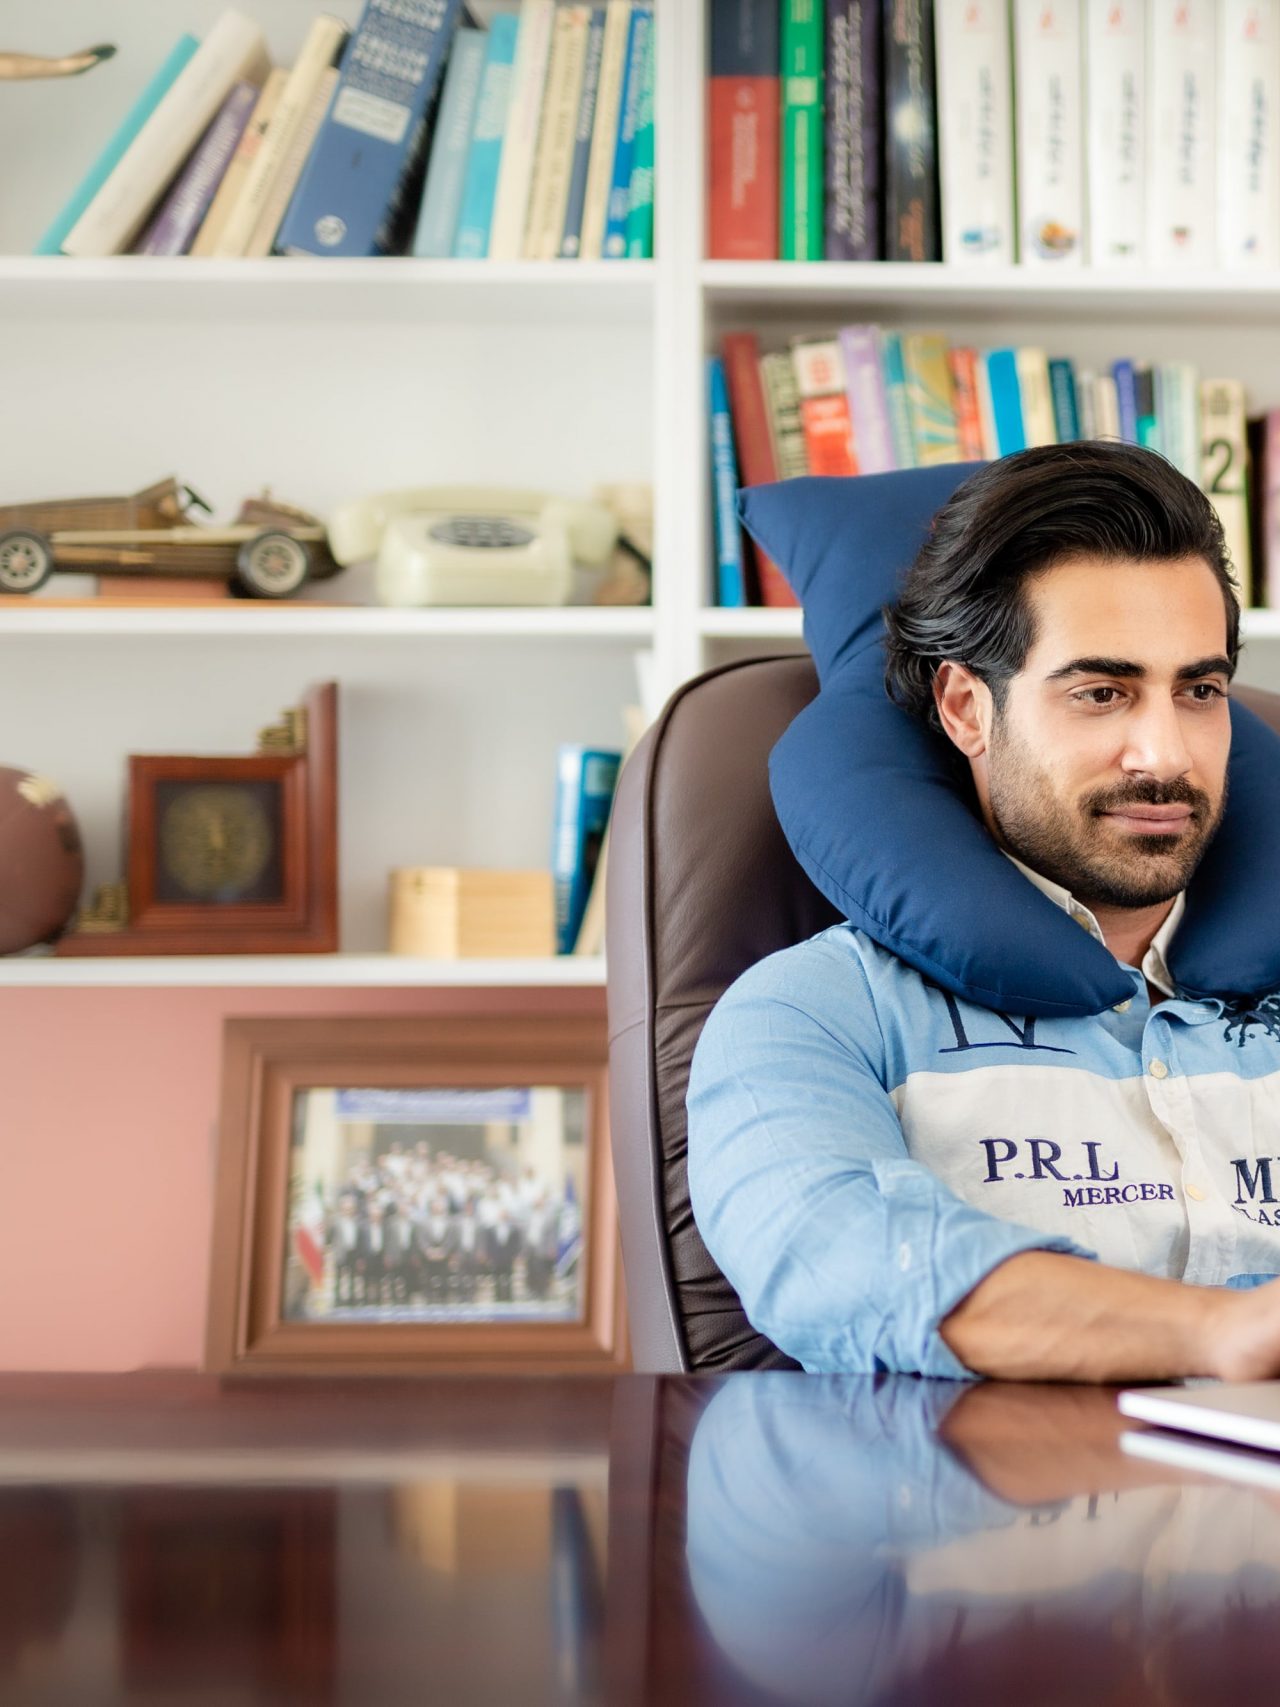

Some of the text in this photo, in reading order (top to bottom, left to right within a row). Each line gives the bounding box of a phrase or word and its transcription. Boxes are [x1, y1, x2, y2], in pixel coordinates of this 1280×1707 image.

[1203, 438, 1245, 494] 2
[979, 1138, 1119, 1182] P.R.L
[1063, 1183, 1174, 1207] MERCER
